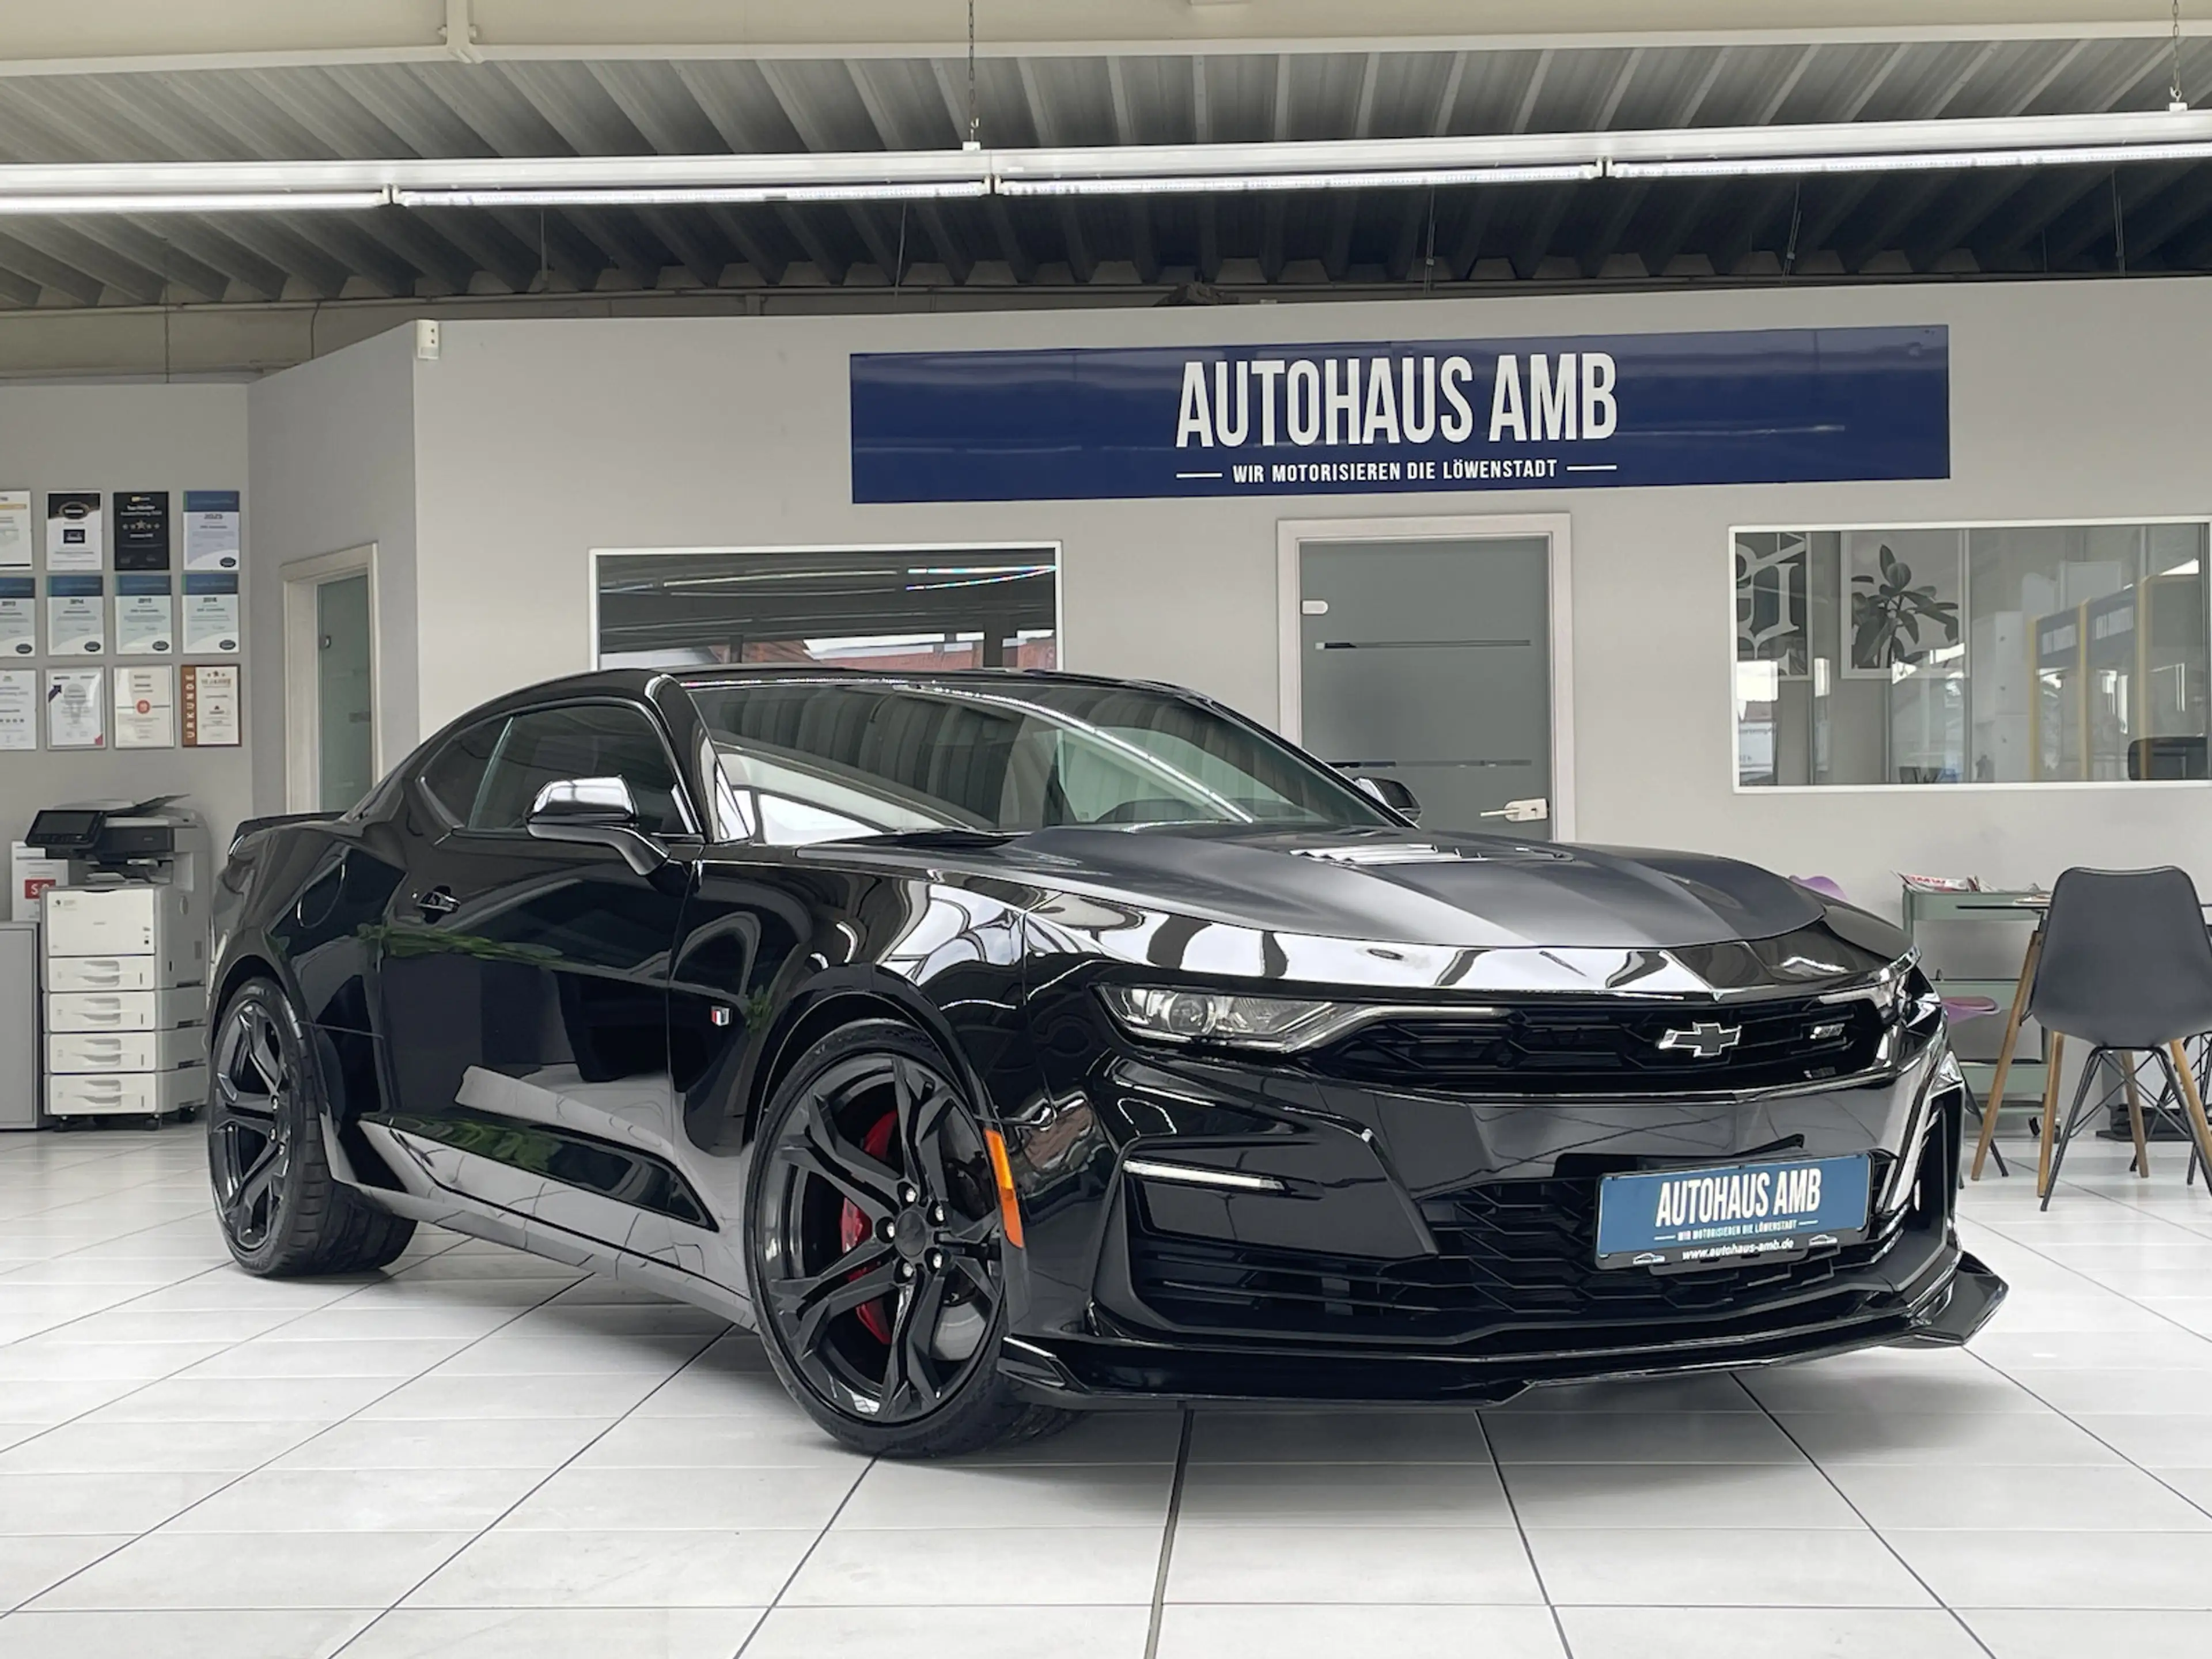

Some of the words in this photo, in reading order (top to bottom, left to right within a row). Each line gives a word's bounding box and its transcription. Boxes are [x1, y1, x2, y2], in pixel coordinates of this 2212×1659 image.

[1176, 355, 1473, 448] AUTOHAUS
[1488, 352, 1617, 442] AMB
[1233, 465, 1264, 483] WIR
[1272, 462, 1400, 482] MOTORISIEREN
[1407, 461, 1436, 479] DIE
[1443, 459, 1557, 479] LÖWENSTADT
[185, 674, 195, 738] URKUNDE
[1655, 1172, 1770, 1227] AUTOHAUS
[1772, 1168, 1821, 1215] AMB
[1682, 1238, 1794, 1260] www.autohaus-amb.de
